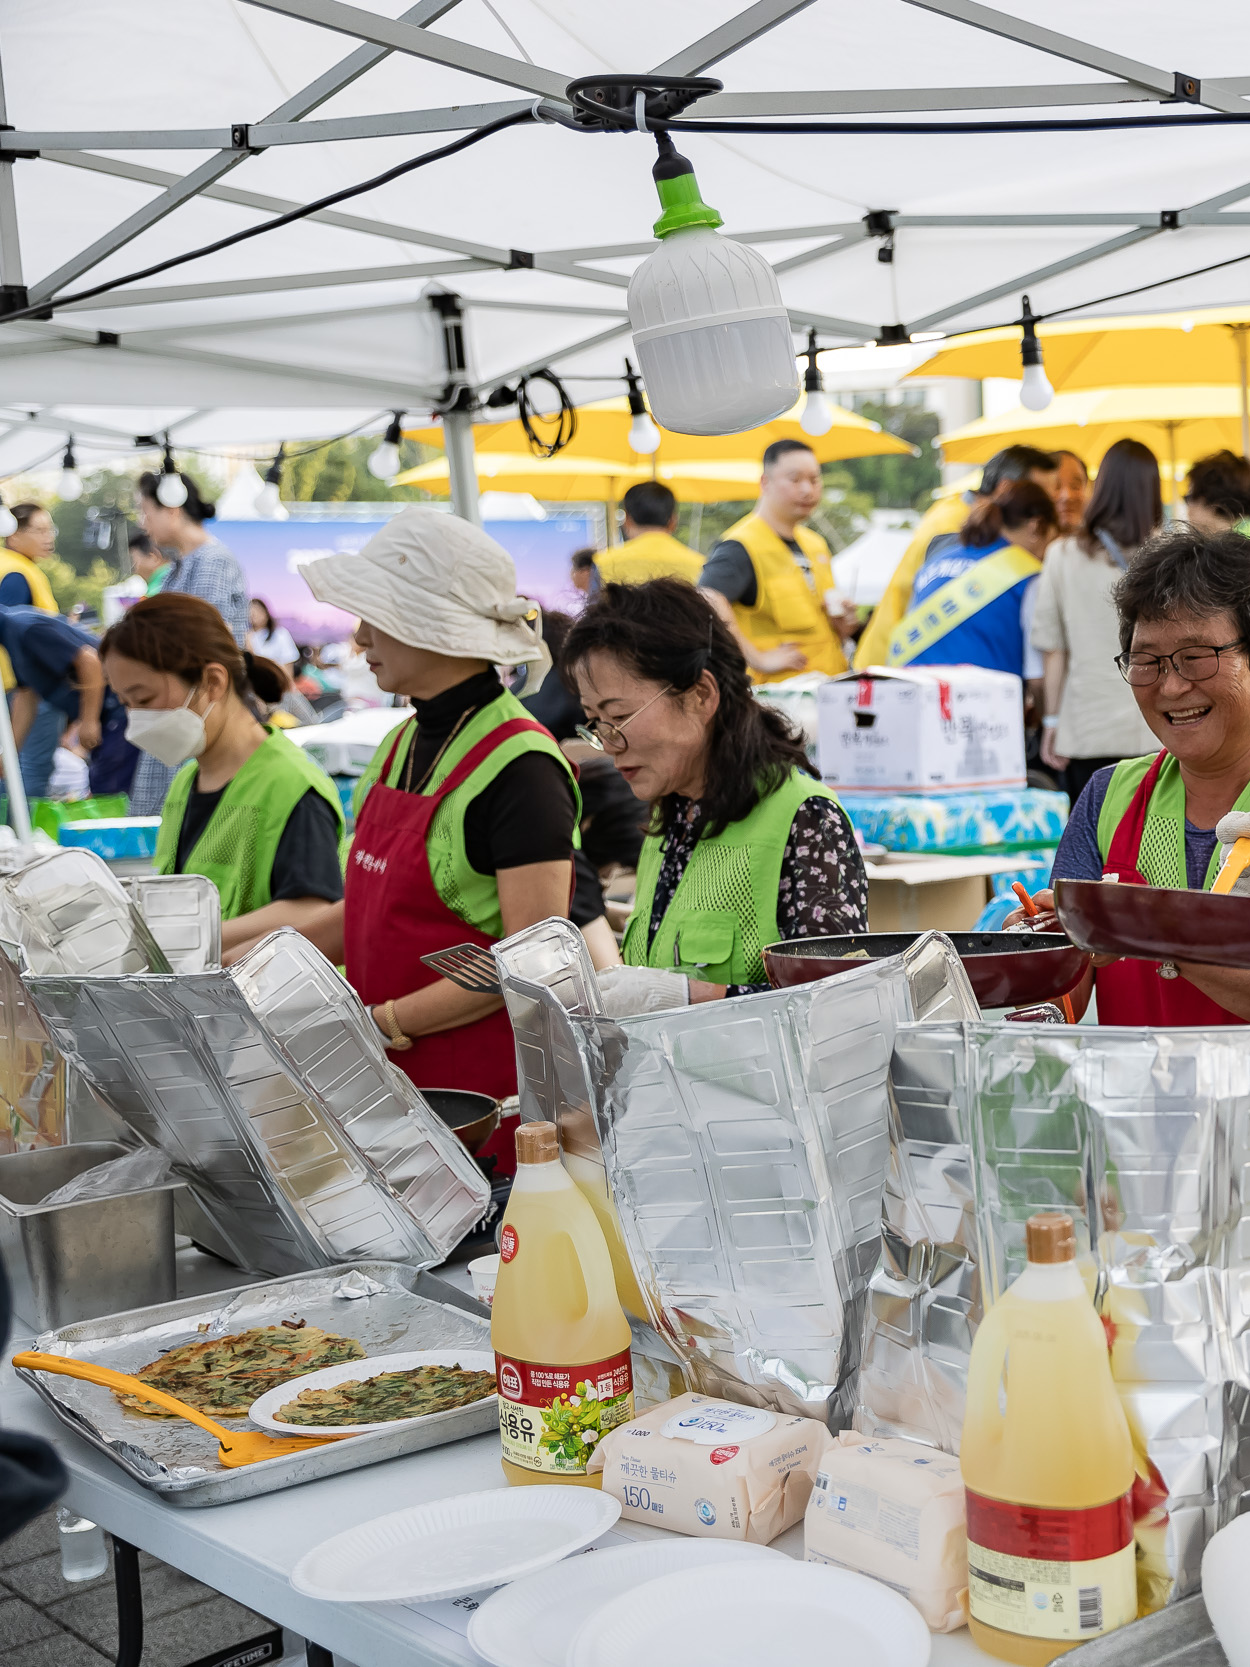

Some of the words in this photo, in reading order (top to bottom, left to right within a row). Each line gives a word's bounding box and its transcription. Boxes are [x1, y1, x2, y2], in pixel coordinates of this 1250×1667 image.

[502, 1374, 519, 1389] 해표
[553, 1380, 570, 1389] 식용유
[500, 1409, 535, 1444] 식용유
[620, 1462, 648, 1479] 깨끗한
[650, 1466, 677, 1484] 물티슈
[222, 1648, 265, 1667] IFETIME
